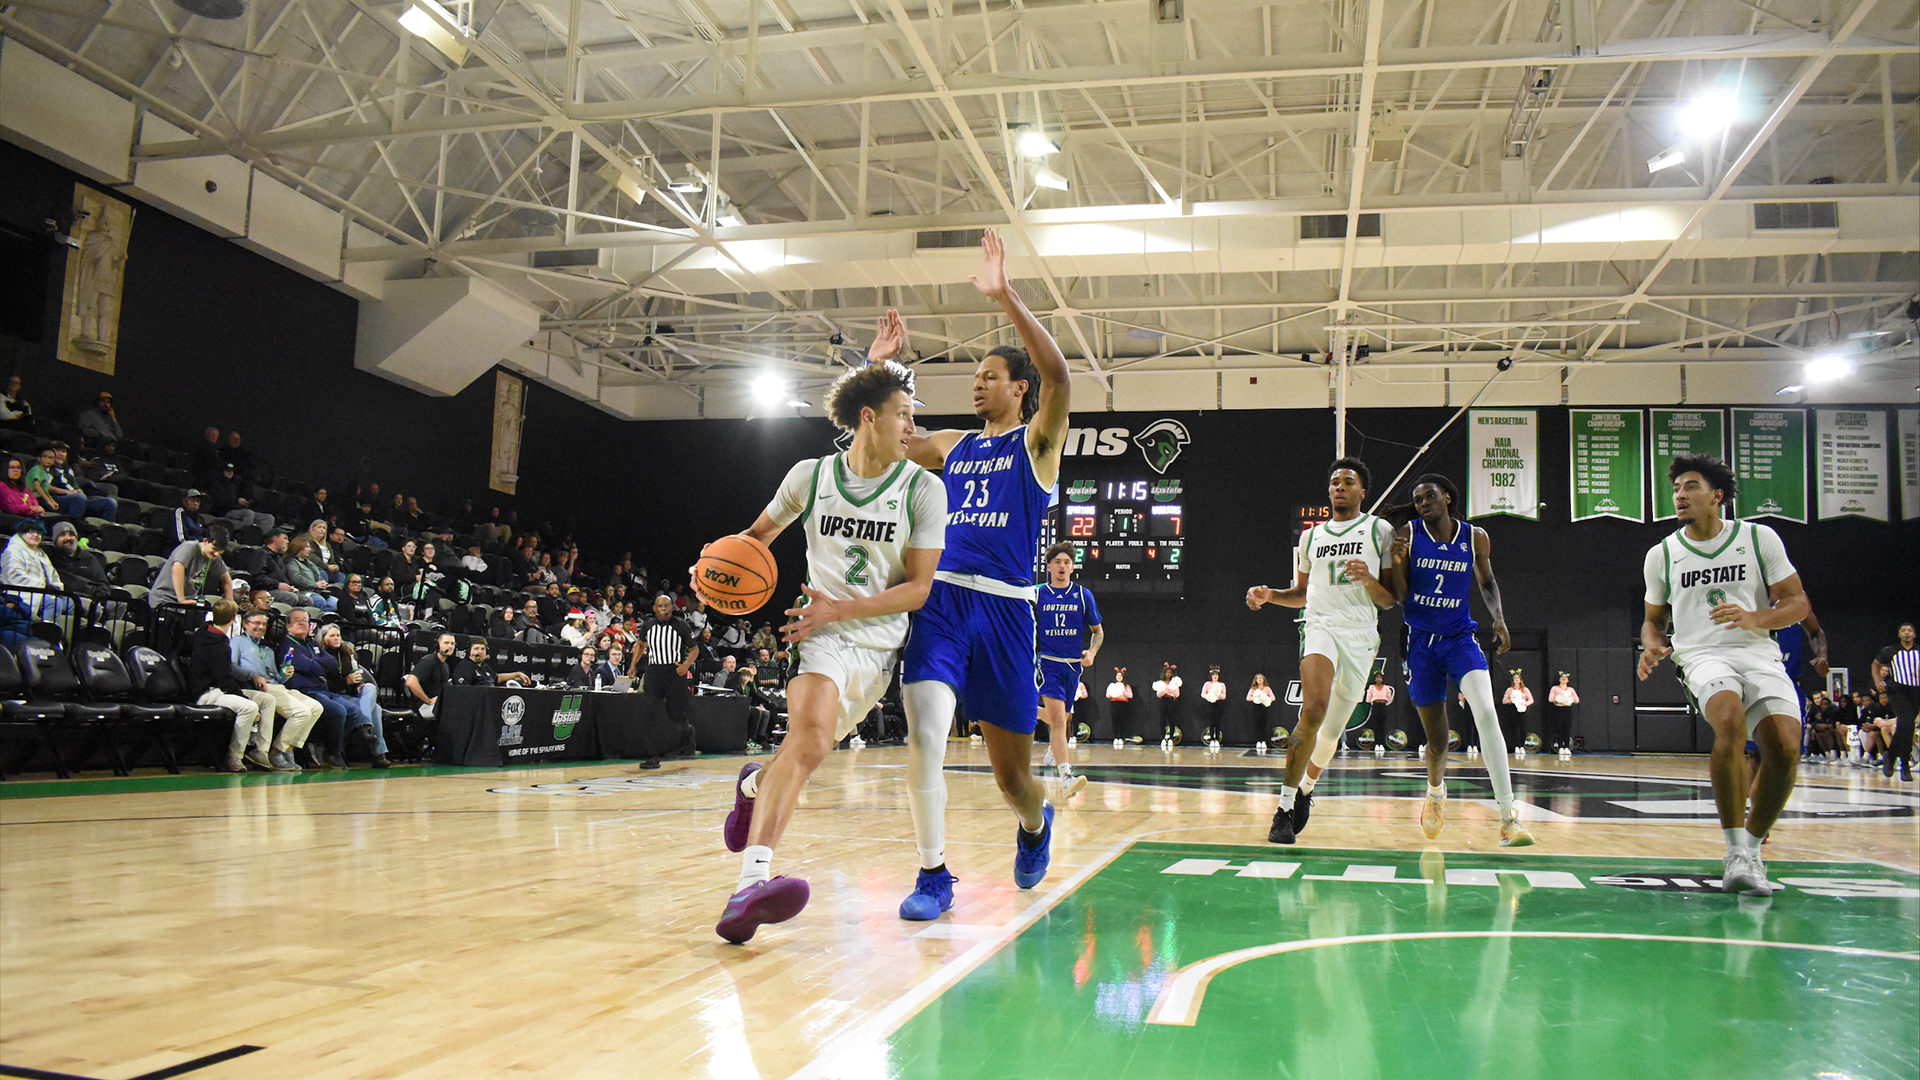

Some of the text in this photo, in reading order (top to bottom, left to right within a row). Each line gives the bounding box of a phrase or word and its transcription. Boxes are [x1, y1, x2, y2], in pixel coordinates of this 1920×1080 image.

[1478, 416, 1528, 425] MEN'S BASKETBALL
[1494, 438, 1512, 447] NAIA
[1486, 448, 1520, 458] NATIONAL
[948, 454, 1014, 475] SOUTHERN
[1482, 459, 1524, 469] CHAMPIONS
[1491, 473, 1515, 487] 1982
[961, 478, 989, 508] 23
[1066, 487, 1098, 495] Upstate
[1107, 481, 1147, 500] 11:15
[1301, 506, 1329, 518] 11:15
[820, 515, 897, 543] UPSTATE
[1072, 517, 1094, 536] 22
[1123, 517, 1128, 530] 1
[1170, 517, 1180, 535] 7
[1041, 528, 1056, 536] 0 0
[1074, 548, 1180, 563] 2 4 4 2
[1316, 542, 1363, 558] UPSTATE
[845, 545, 869, 586] 2
[1417, 558, 1468, 572] SOUTHERN
[703, 568, 740, 587] NCAA
[1434, 573, 1445, 594] 2
[1680, 564, 1747, 589] UPSTATE
[1043, 604, 1078, 612] SOUTHERN
[1054, 613, 1066, 627] 12
[1045, 629, 1077, 637] WESLEYAN
[514, 654, 528, 664] ingles
[507, 702, 520, 714] FOX
[552, 710, 582, 725] Upstate
